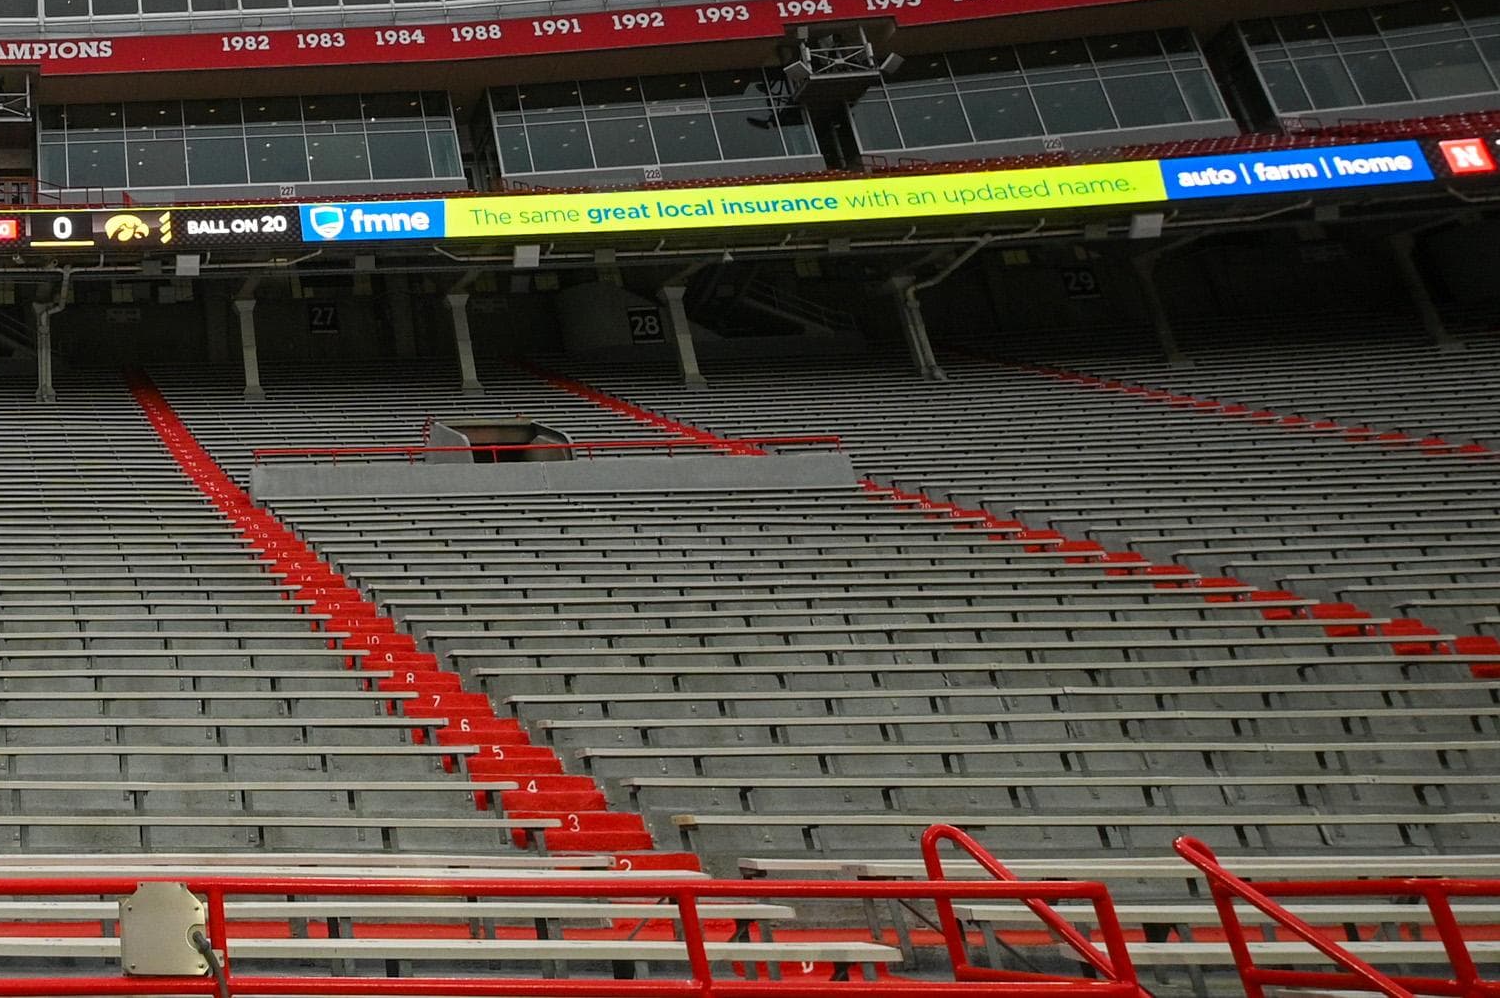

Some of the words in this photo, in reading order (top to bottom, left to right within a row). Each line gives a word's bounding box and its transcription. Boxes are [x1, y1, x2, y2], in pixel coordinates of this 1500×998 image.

[611, 11, 665, 30] 1992
[695, 5, 750, 24] 1993
[450, 24, 502, 42] 1988
[532, 18, 582, 36] 1991
[221, 35, 270, 52] 1982
[296, 32, 346, 49] 1983
[375, 29, 425, 46] 1984
[1451, 146, 1484, 167] N
[1177, 164, 1237, 188] auto
[1253, 161, 1318, 182] farm
[1333, 153, 1413, 176] home
[281, 186, 294, 196] 227
[469, 208, 512, 226] The
[519, 207, 580, 225] same
[586, 203, 650, 225] great
[656, 199, 714, 218] local
[720, 193, 839, 216] insurance
[845, 189, 900, 209] with
[906, 190, 937, 206] an
[945, 177, 1052, 207] updated
[1058, 177, 1137, 199] name.
[53, 216, 72, 240] 0
[187, 219, 229, 235] BALL
[232, 218, 259, 234] ON
[261, 215, 287, 233] 20
[350, 209, 430, 233] fmne
[1064, 271, 1095, 291] 29
[312, 307, 334, 326] 27
[631, 315, 660, 335] 28
[385, 652, 394, 662] 9
[432, 695, 441, 708] 7
[460, 718, 471, 732] 6
[492, 745, 504, 760] 5
[526, 780, 539, 793] 4
[568, 814, 581, 832] 3
